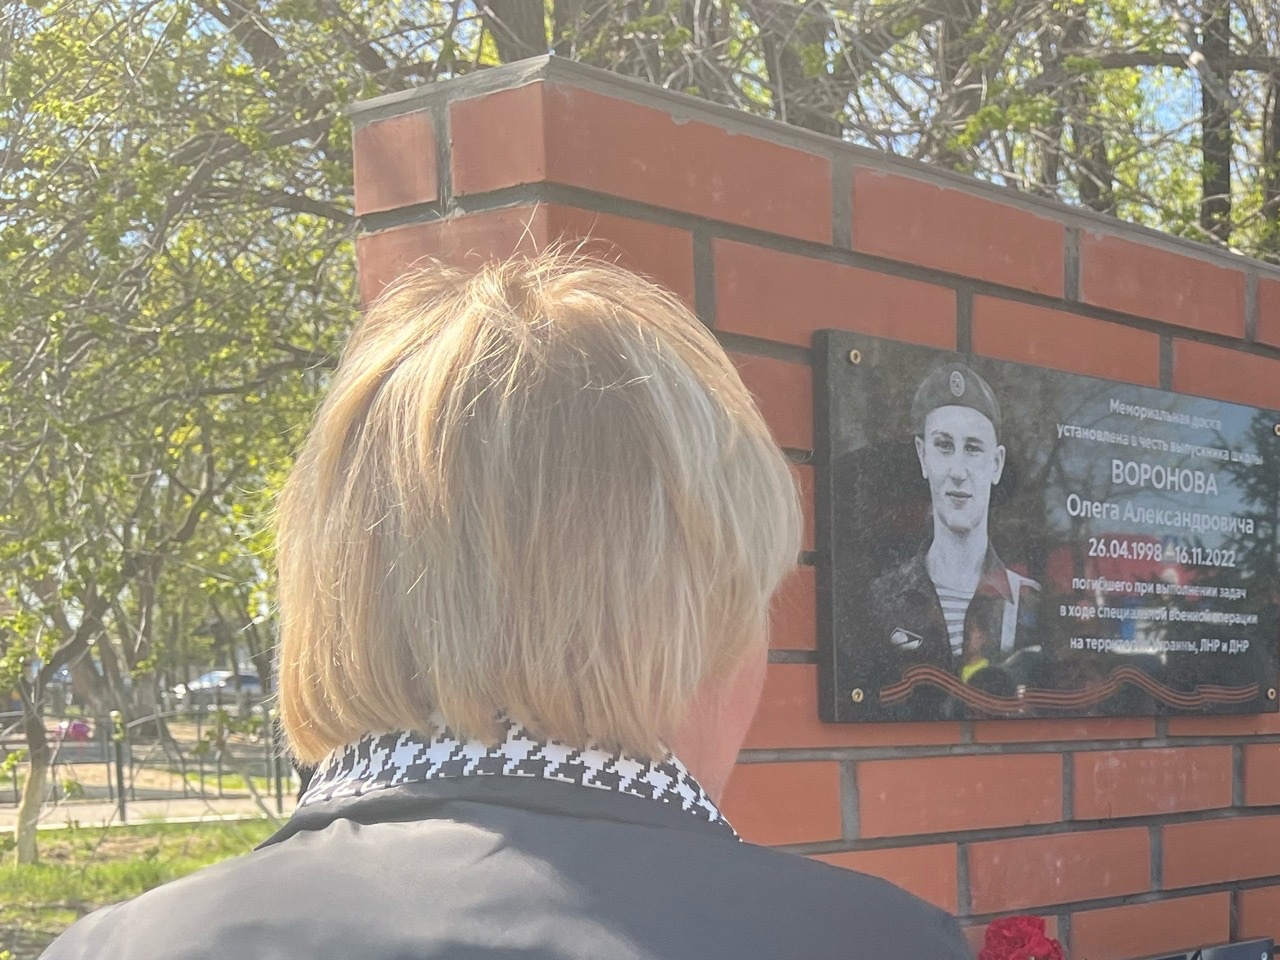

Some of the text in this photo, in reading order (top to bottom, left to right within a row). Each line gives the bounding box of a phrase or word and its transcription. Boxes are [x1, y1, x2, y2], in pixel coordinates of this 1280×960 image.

[1109, 398, 1221, 429] Мемориальная доска
[1056, 423, 1263, 466] установлена в честь выпускника школы
[1111, 459, 1218, 496] ВОРОНОВА
[1066, 493, 1254, 534] Олега Александровича
[1088, 537, 1162, 561] 26.04.1998
[1175, 546, 1236, 567] 16.11.2022
[1072, 576, 1246, 601] погибшего при выполнении задач
[1060, 605, 1258, 626] в ходе специальной военной операции
[1070, 637, 1084, 649] на
[1200, 639, 1220, 652] ЛНР
[1222, 642, 1228, 652] и
[1228, 639, 1249, 655] ДНР
